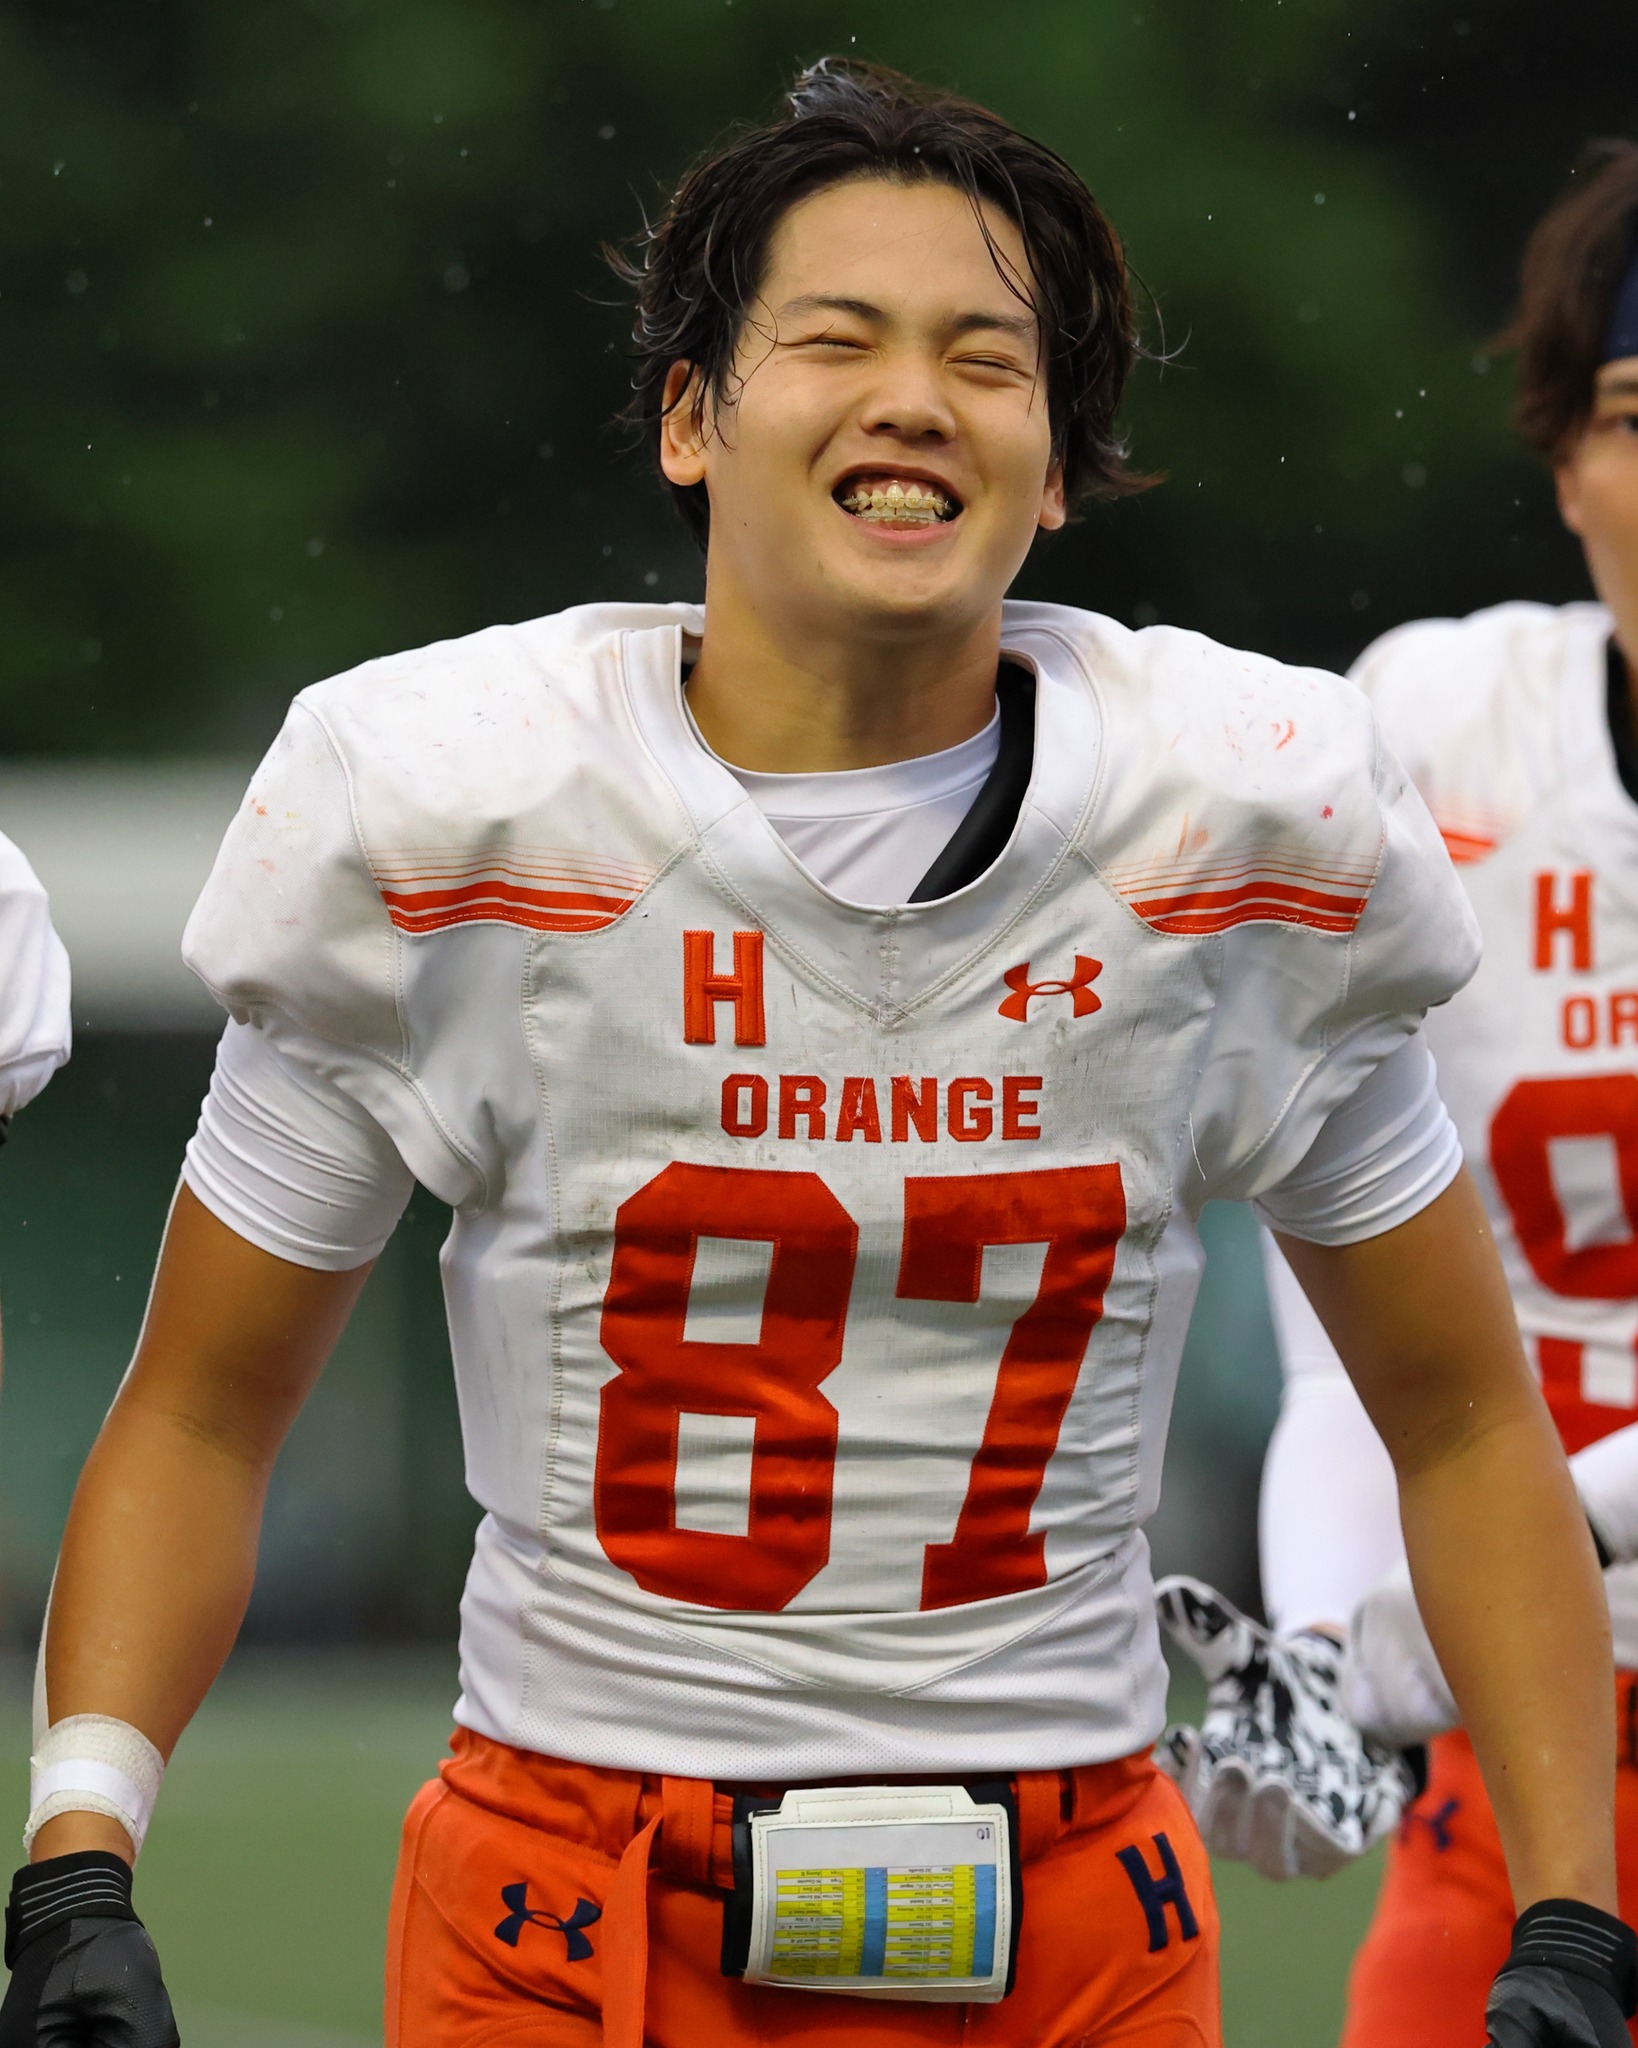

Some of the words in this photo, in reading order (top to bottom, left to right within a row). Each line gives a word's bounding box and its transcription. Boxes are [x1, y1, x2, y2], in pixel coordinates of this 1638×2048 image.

[1533, 869, 1593, 970] H
[683, 930, 766, 1046] H
[721, 1073, 1043, 1143] ORANGE
[593, 1160, 1127, 1612] 87
[1115, 1832, 1199, 1953] H
